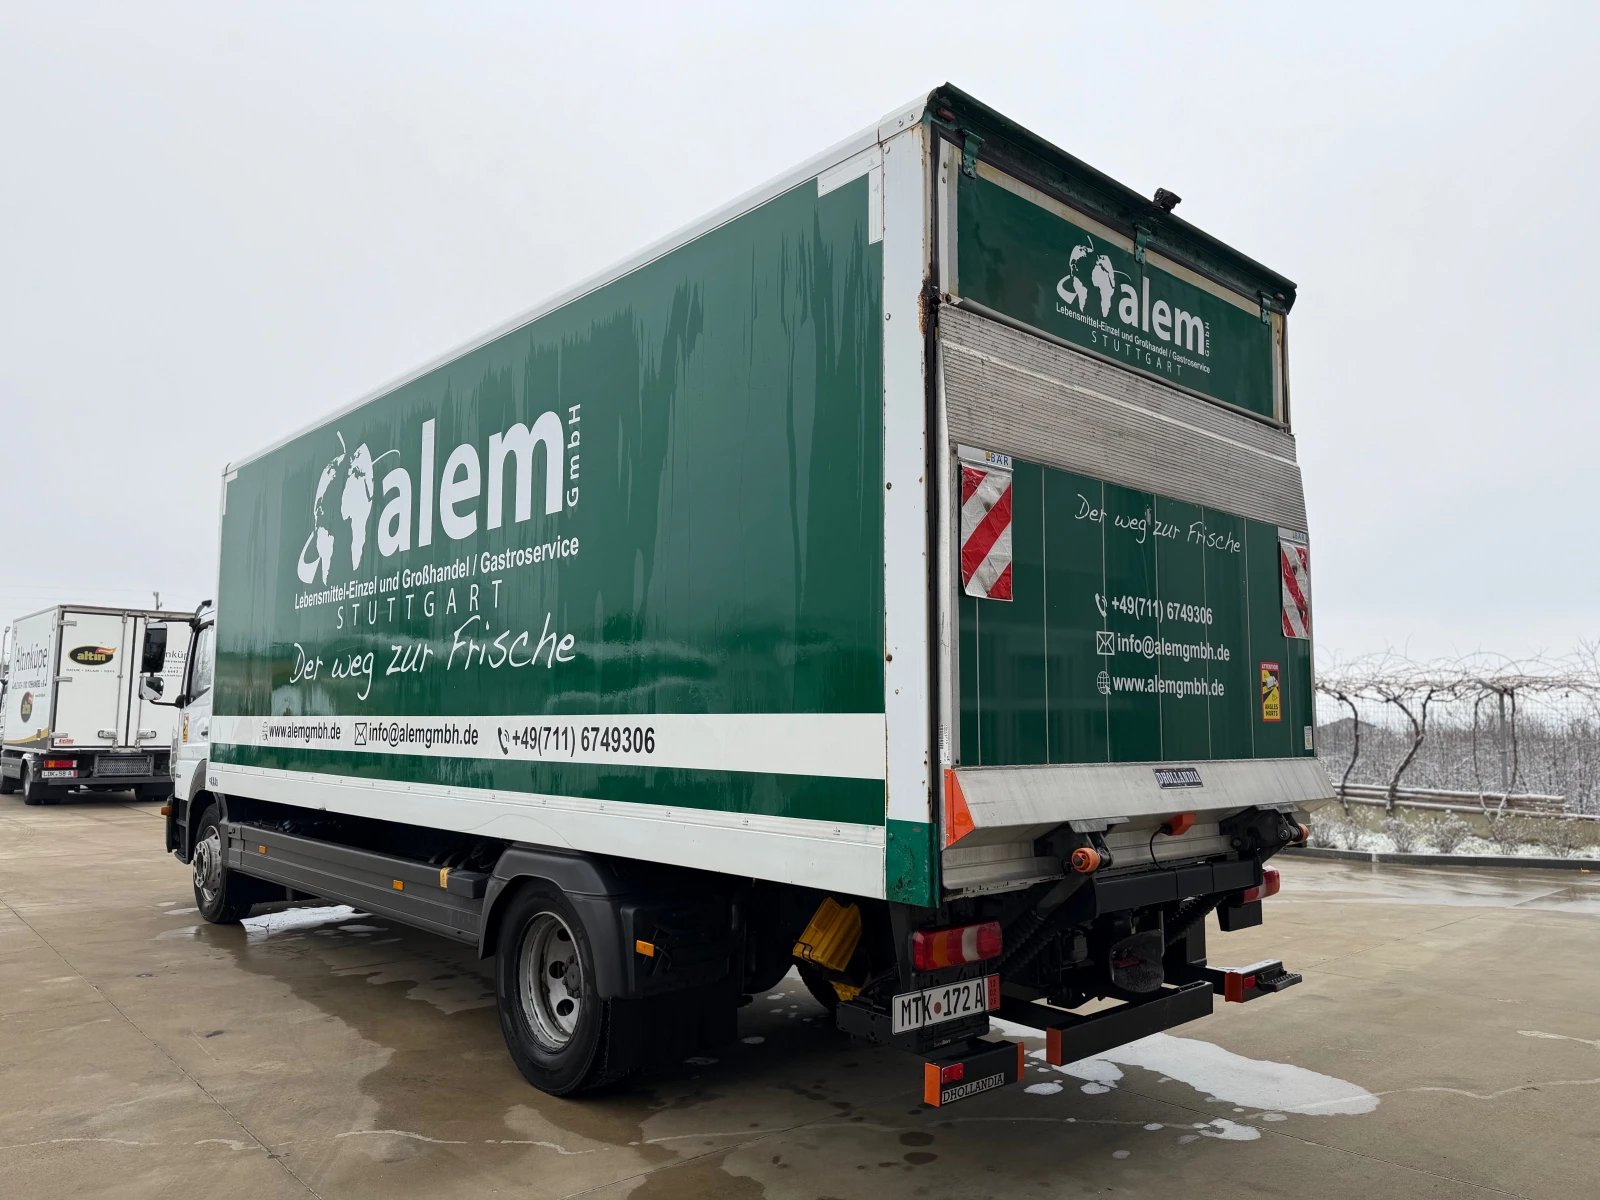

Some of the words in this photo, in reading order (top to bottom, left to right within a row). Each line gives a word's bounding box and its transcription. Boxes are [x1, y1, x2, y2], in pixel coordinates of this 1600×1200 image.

[1056, 302, 1120, 338] Lebensmittel-Einzel
[1121, 331, 1134, 343] und
[1134, 336, 1168, 357] Großhandel
[1172, 351, 1211, 374] Gastroservice
[1118, 276, 1205, 356] alem
[1091, 331, 1182, 377] STUTTGART
[566, 403, 581, 508] GmbH
[990, 452, 1009, 466] BÄR
[377, 410, 564, 557] alem
[1075, 494, 1108, 523] Der
[1114, 514, 1147, 544] weg
[1152, 520, 1181, 539] zur
[1187, 521, 1241, 553] Frische
[294, 576, 377, 610] Lebensmittel-Einzel
[379, 571, 399, 594] und
[402, 556, 470, 588] Großhandel
[480, 535, 580, 574] Gastroservice
[336, 579, 503, 630] STUTTGART
[1111, 595, 1164, 623] +49(711)
[1166, 602, 1213, 625] 6749306
[289, 642, 324, 684] Der
[331, 651, 375, 701] weg
[385, 643, 434, 677] zur
[446, 612, 576, 671] Frische
[1117, 633, 1230, 662] info@alemgmbh.de
[1112, 675, 1225, 699] www.alemgmbh.de
[268, 722, 342, 743] www.alemgmbh.de
[368, 722, 479, 749] info@alemgmbh.de
[511, 726, 576, 757] +49(711)
[580, 727, 656, 754] 6749306
[1155, 770, 1202, 785] DHOLLANDIA
[901, 994, 932, 1027] MTK
[943, 985, 971, 1017] 172
[974, 982, 984, 1009] A
[942, 1073, 1005, 1104] DHOLLANDIA
